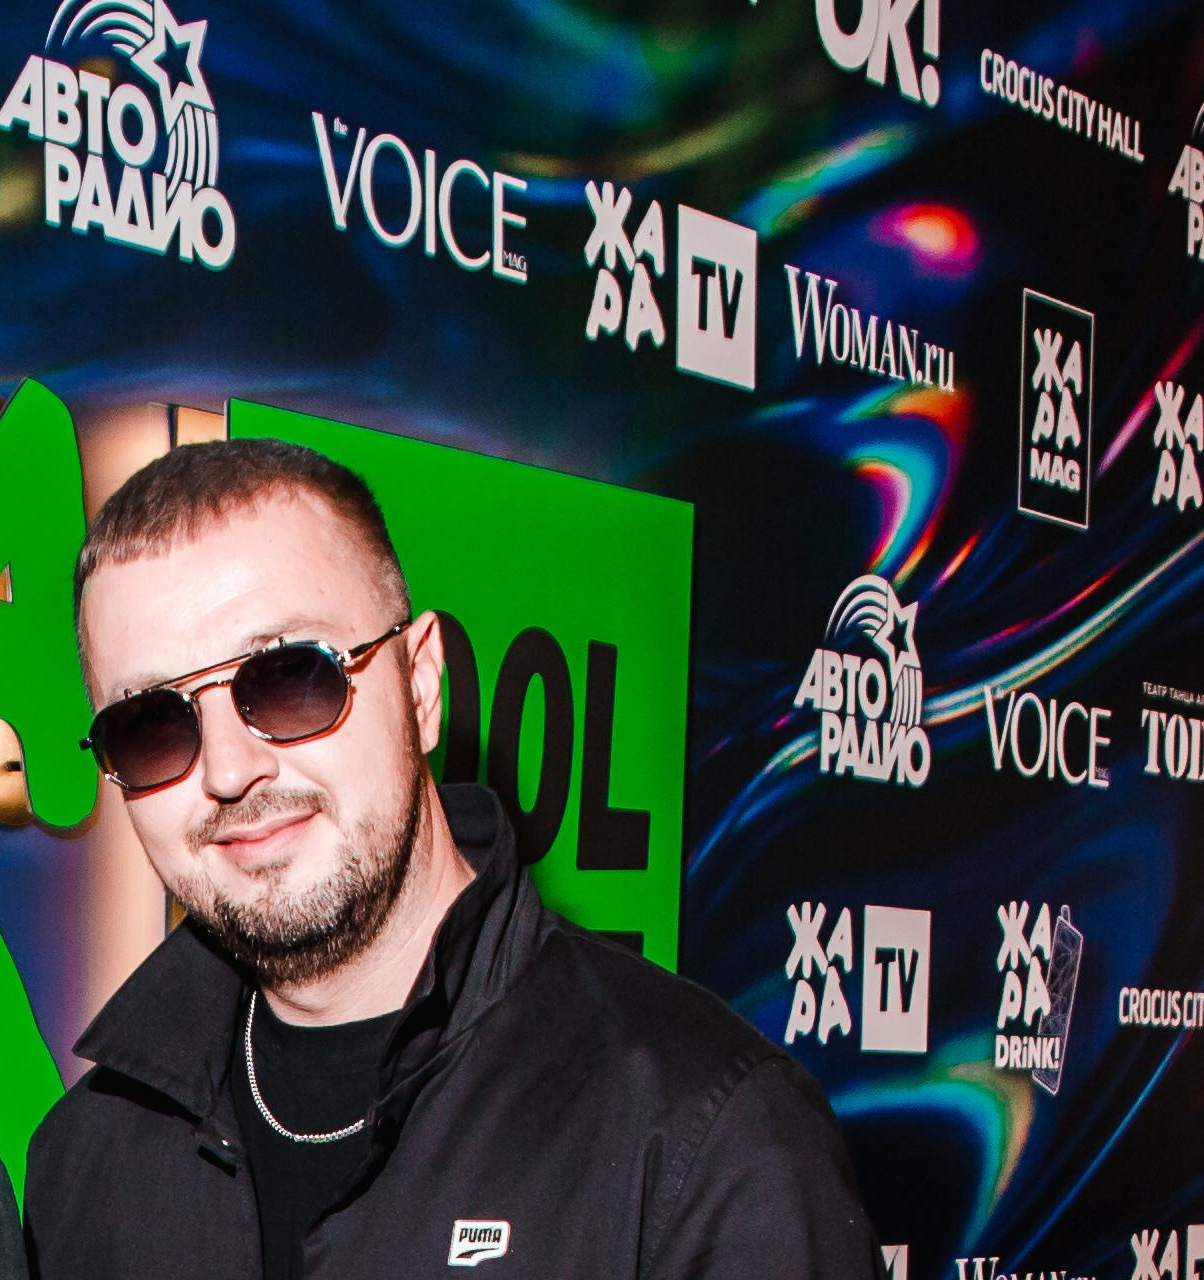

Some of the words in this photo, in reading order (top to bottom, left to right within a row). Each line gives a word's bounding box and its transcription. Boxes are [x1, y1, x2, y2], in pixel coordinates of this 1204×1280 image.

[980, 48, 1055, 120] CROCUS
[1057, 85, 1097, 139] CITY
[1097, 103, 1145, 163] HALL
[45, 142, 236, 271] РАДИО
[311, 112, 528, 284] VOICE
[502, 251, 527, 272] MAG
[691, 255, 743, 340] TV
[1030, 448, 1080, 492] MAG
[794, 648, 887, 722] АВТО
[820, 710, 932, 788] РАДИО
[983, 684, 1112, 789] VOICE
[875, 947, 919, 1014] TV
[1118, 986, 1181, 1028] CROCUS
[458, 1227, 502, 1243] PUMA
